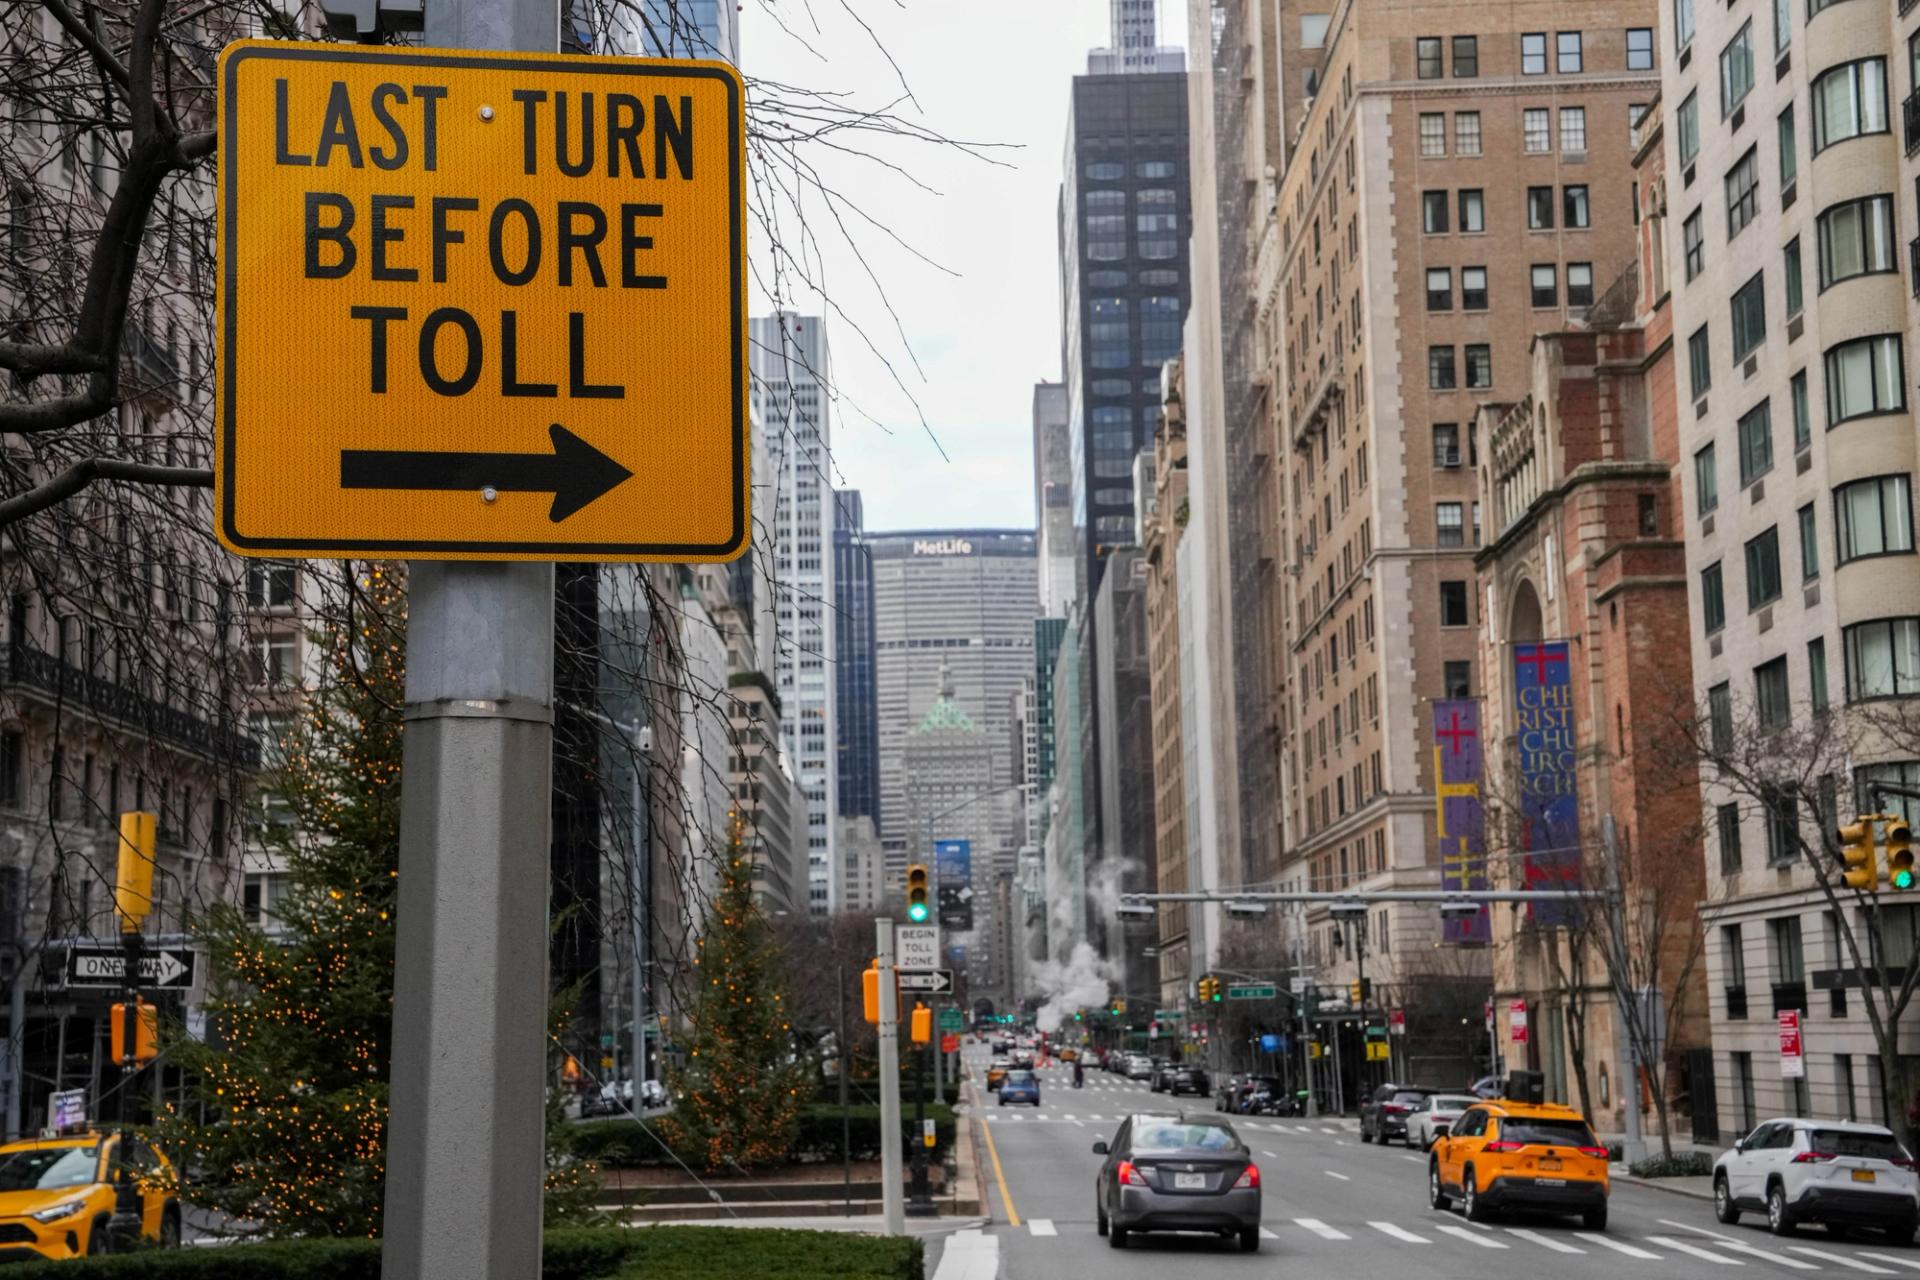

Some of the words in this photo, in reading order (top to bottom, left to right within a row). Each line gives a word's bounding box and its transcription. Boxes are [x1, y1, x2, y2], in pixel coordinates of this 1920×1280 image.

[275, 78, 448, 171] LAST
[512, 89, 694, 181] TURN
[304, 191, 668, 290] BEFORE
[350, 305, 626, 400] TOLL
[913, 539, 972, 555] MetLife
[902, 930, 935, 939] BEGIN
[905, 943, 933, 952] TOLL
[86, 959, 122, 977] ONE
[139, 959, 176, 977] WAY
[904, 956, 934, 965] ZONE
[922, 977, 941, 985] WAY
